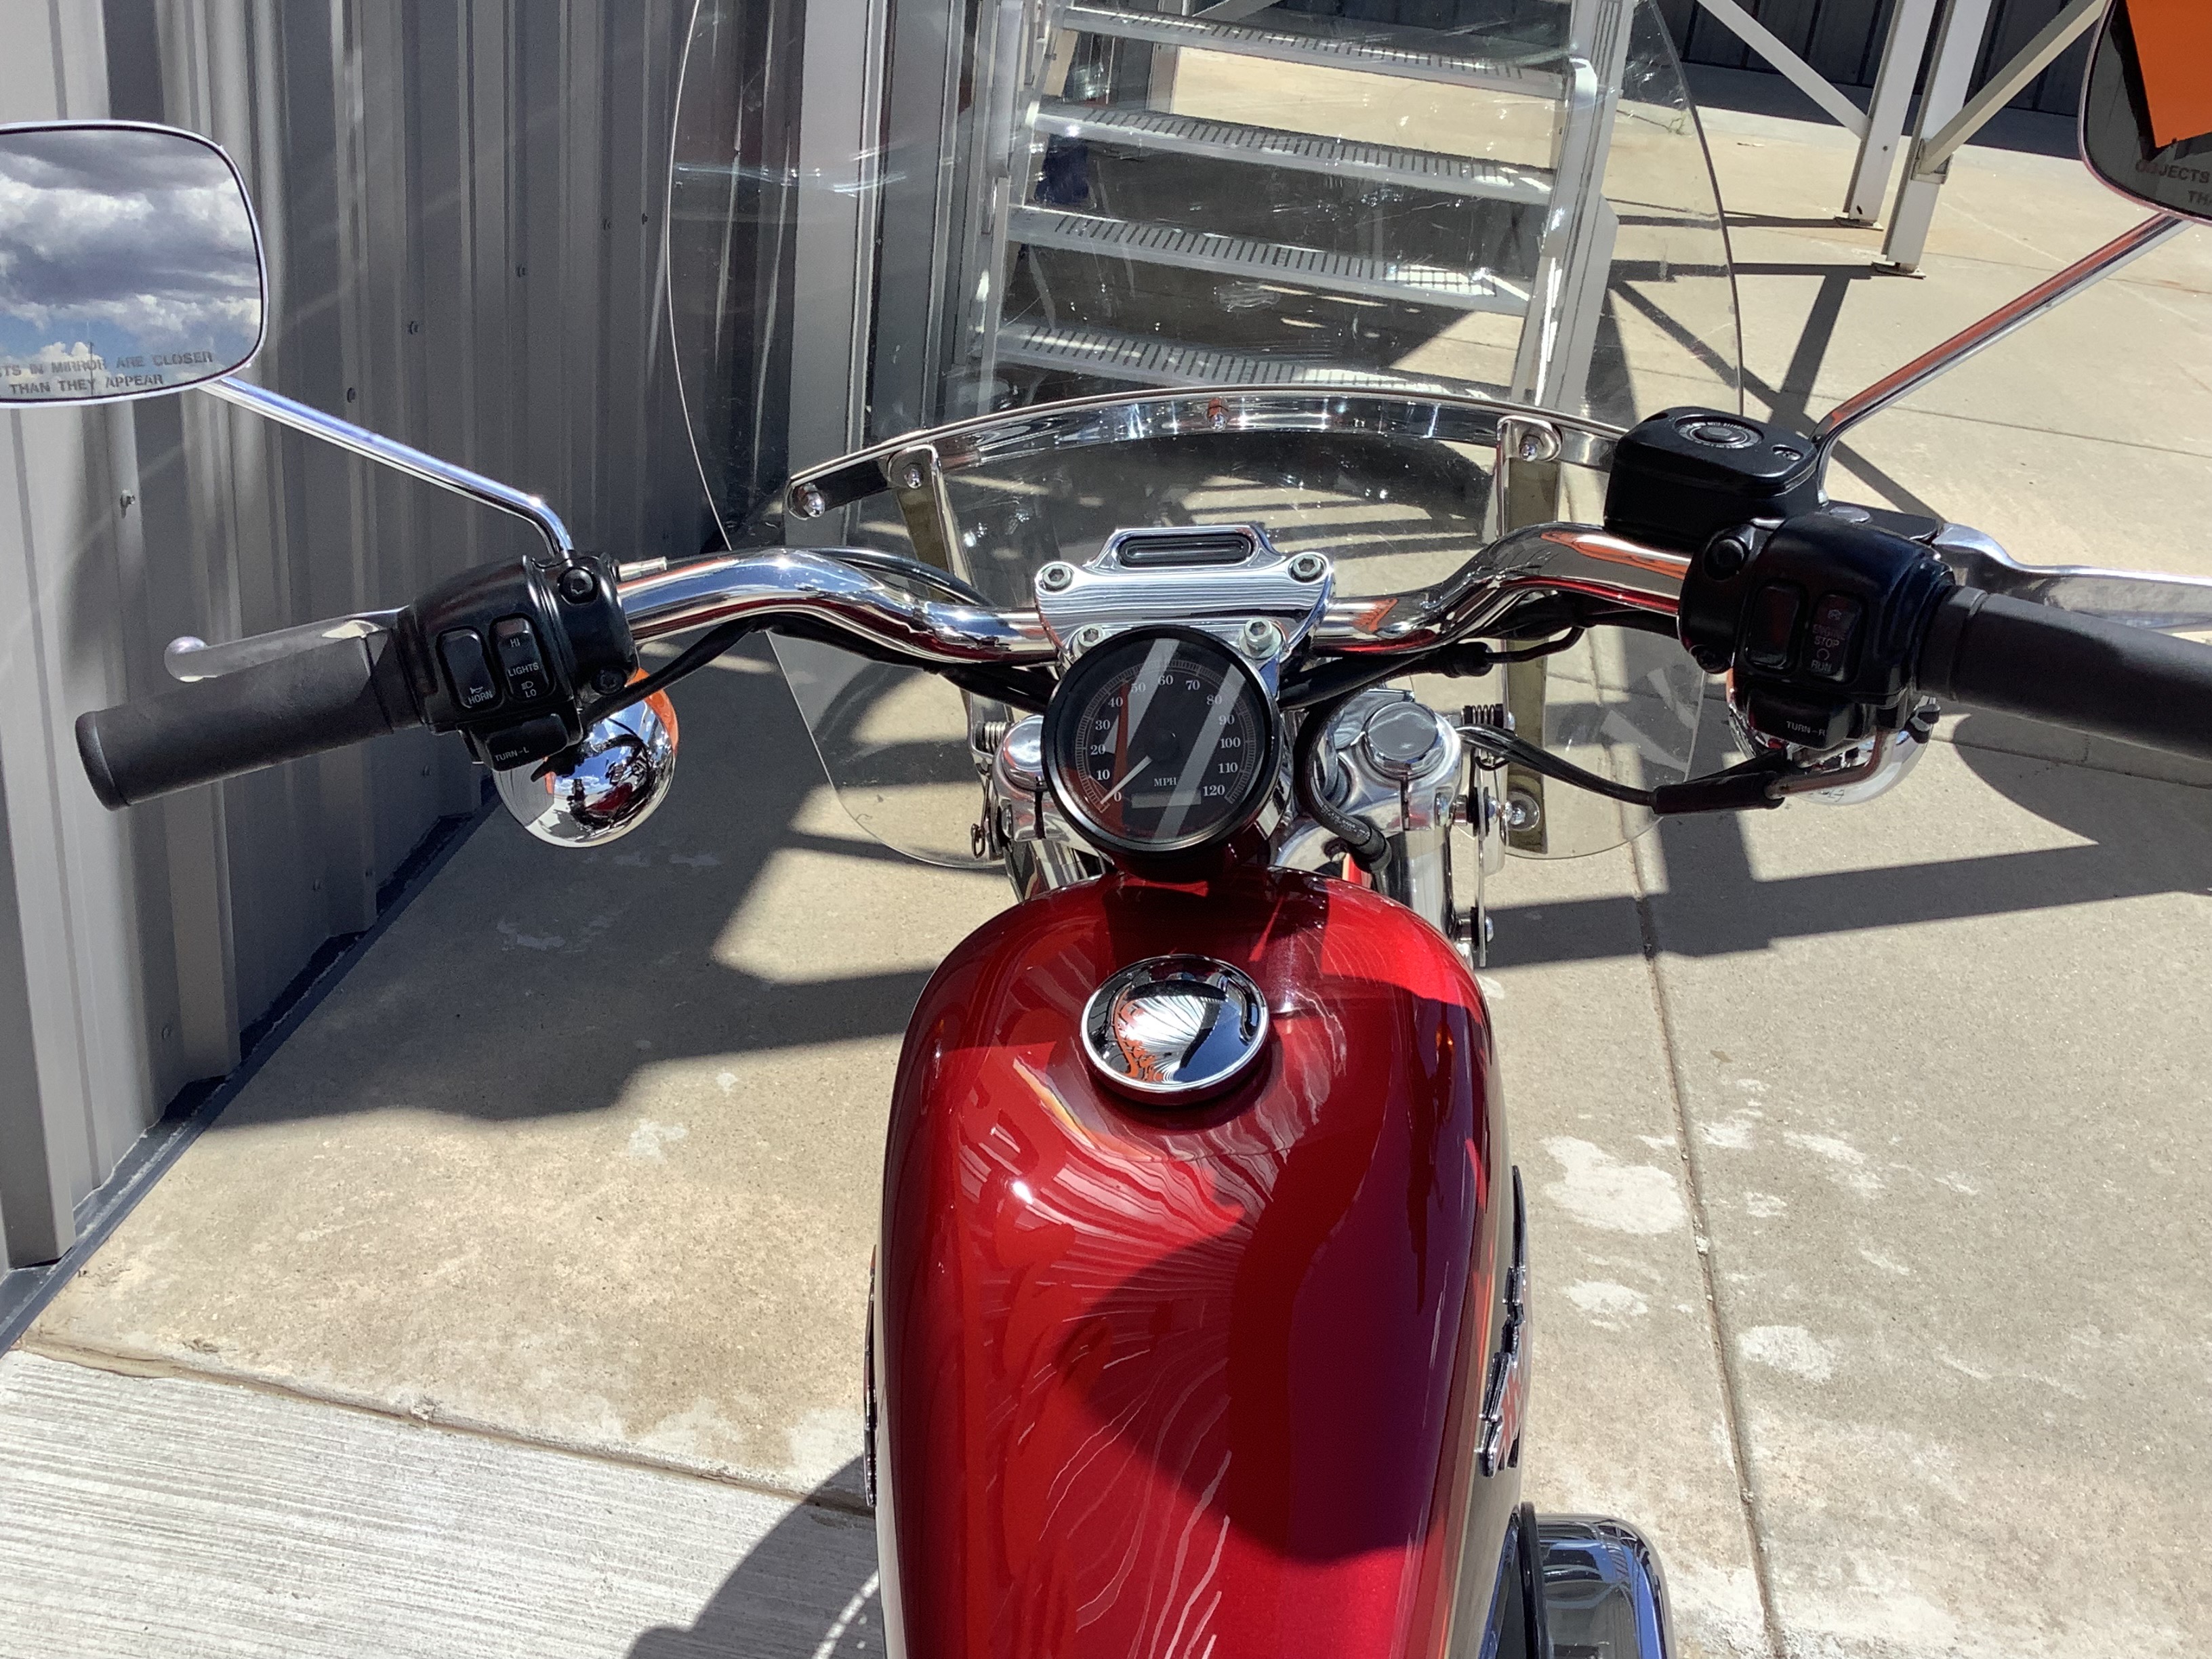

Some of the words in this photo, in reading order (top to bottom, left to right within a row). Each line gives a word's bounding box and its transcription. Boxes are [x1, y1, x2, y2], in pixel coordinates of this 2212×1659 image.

[2188, 190, 2212, 207] TH
[0, 364, 21, 377] TS
[29, 364, 43, 375] IN
[52, 359, 106, 373] MIRROR
[116, 355, 146, 369] ARE
[152, 351, 213, 367] CLOSER
[9, 382, 50, 394] THAN
[58, 378, 94, 392] THEY
[105, 374, 163, 389] APPEAR
[510, 638, 520, 648] HI
[1814, 635, 1840, 648] STOP
[508, 662, 539, 677] LIGHTS
[1810, 659, 1832, 672] RUN
[1158, 675, 1173, 686] 60
[1186, 680, 1201, 691] 70
[1130, 682, 1146, 693] 50
[468, 691, 493, 705] HORN
[525, 689, 537, 699] LO
[1107, 697, 1123, 708] 40
[1206, 695, 1222, 705] 80
[1095, 720, 1111, 731] 30
[1218, 715, 1235, 725] 90
[1220, 737, 1241, 748] 100
[1090, 745, 1106, 756] 20
[1218, 762, 1238, 773] 110
[1096, 769, 1110, 781] 10
[1153, 777, 1178, 787] MPH
[1202, 785, 1225, 797] 120
[1113, 792, 1122, 802] 0
